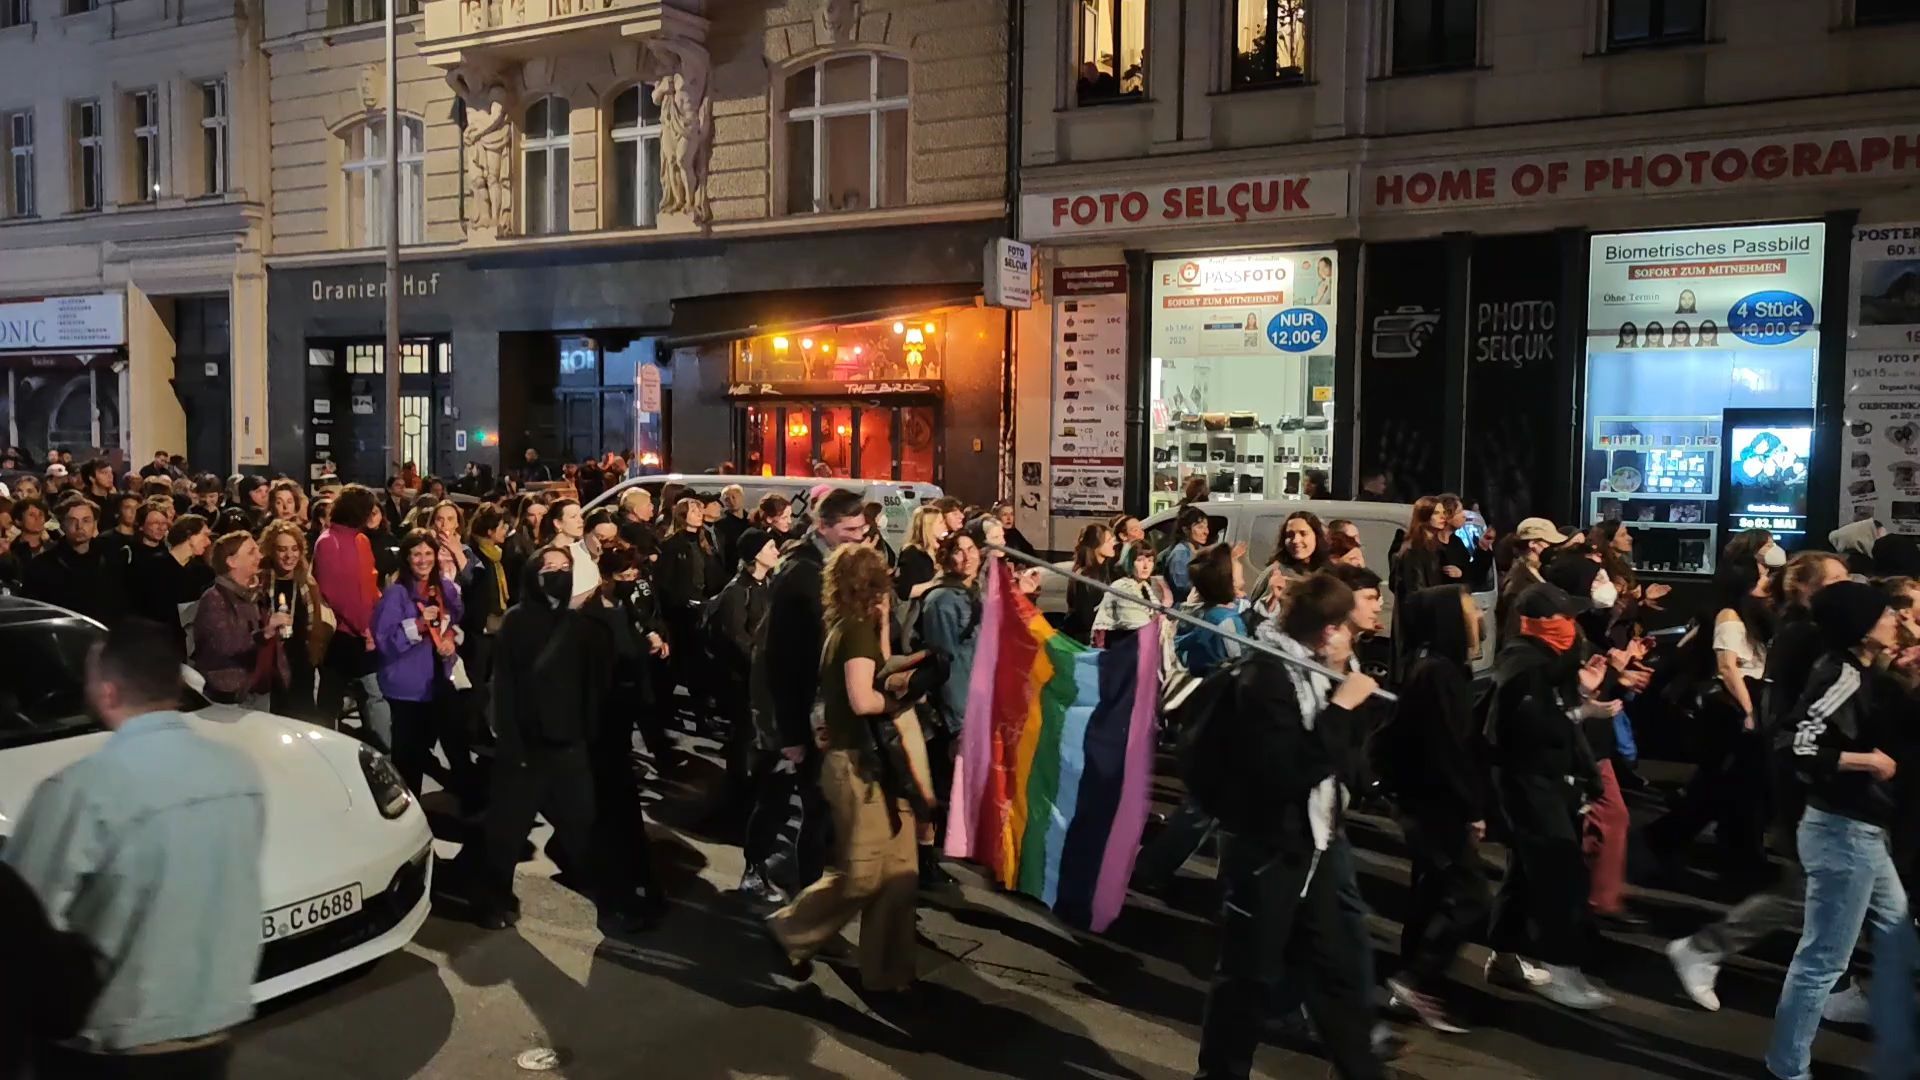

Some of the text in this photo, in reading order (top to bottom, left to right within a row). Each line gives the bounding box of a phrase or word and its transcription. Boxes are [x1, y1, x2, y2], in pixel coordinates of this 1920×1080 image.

[1376, 135, 1920, 206] HOME OF PHOTOGRAPH
[1052, 178, 1311, 226] FOTO SELÇUK
[1008, 245, 1024, 257] FOTO
[1605, 236, 1810, 260] Biometrisches Passbild
[1887, 244, 1905, 256] 60
[1004, 257, 1028, 272] SELÇUK
[1634, 262, 1781, 279] SOFORT ZUM MITNEHMEN
[1205, 267, 1287, 284] PASSFOTO
[312, 272, 441, 301] Oranien Hof
[1167, 294, 1280, 308] SOFORT ZUM MITNEHMEN
[1603, 292, 1660, 303] Ohne Termin
[1478, 301, 1555, 333] PHOTO
[1737, 301, 1804, 318] 4 Stück
[1280, 312, 1315, 327] NUR
[1271, 330, 1323, 346] 12,00€
[1476, 334, 1554, 368] SELÇUK
[1878, 354, 1910, 363] FOTO
[307, 890, 354, 924] 6688
